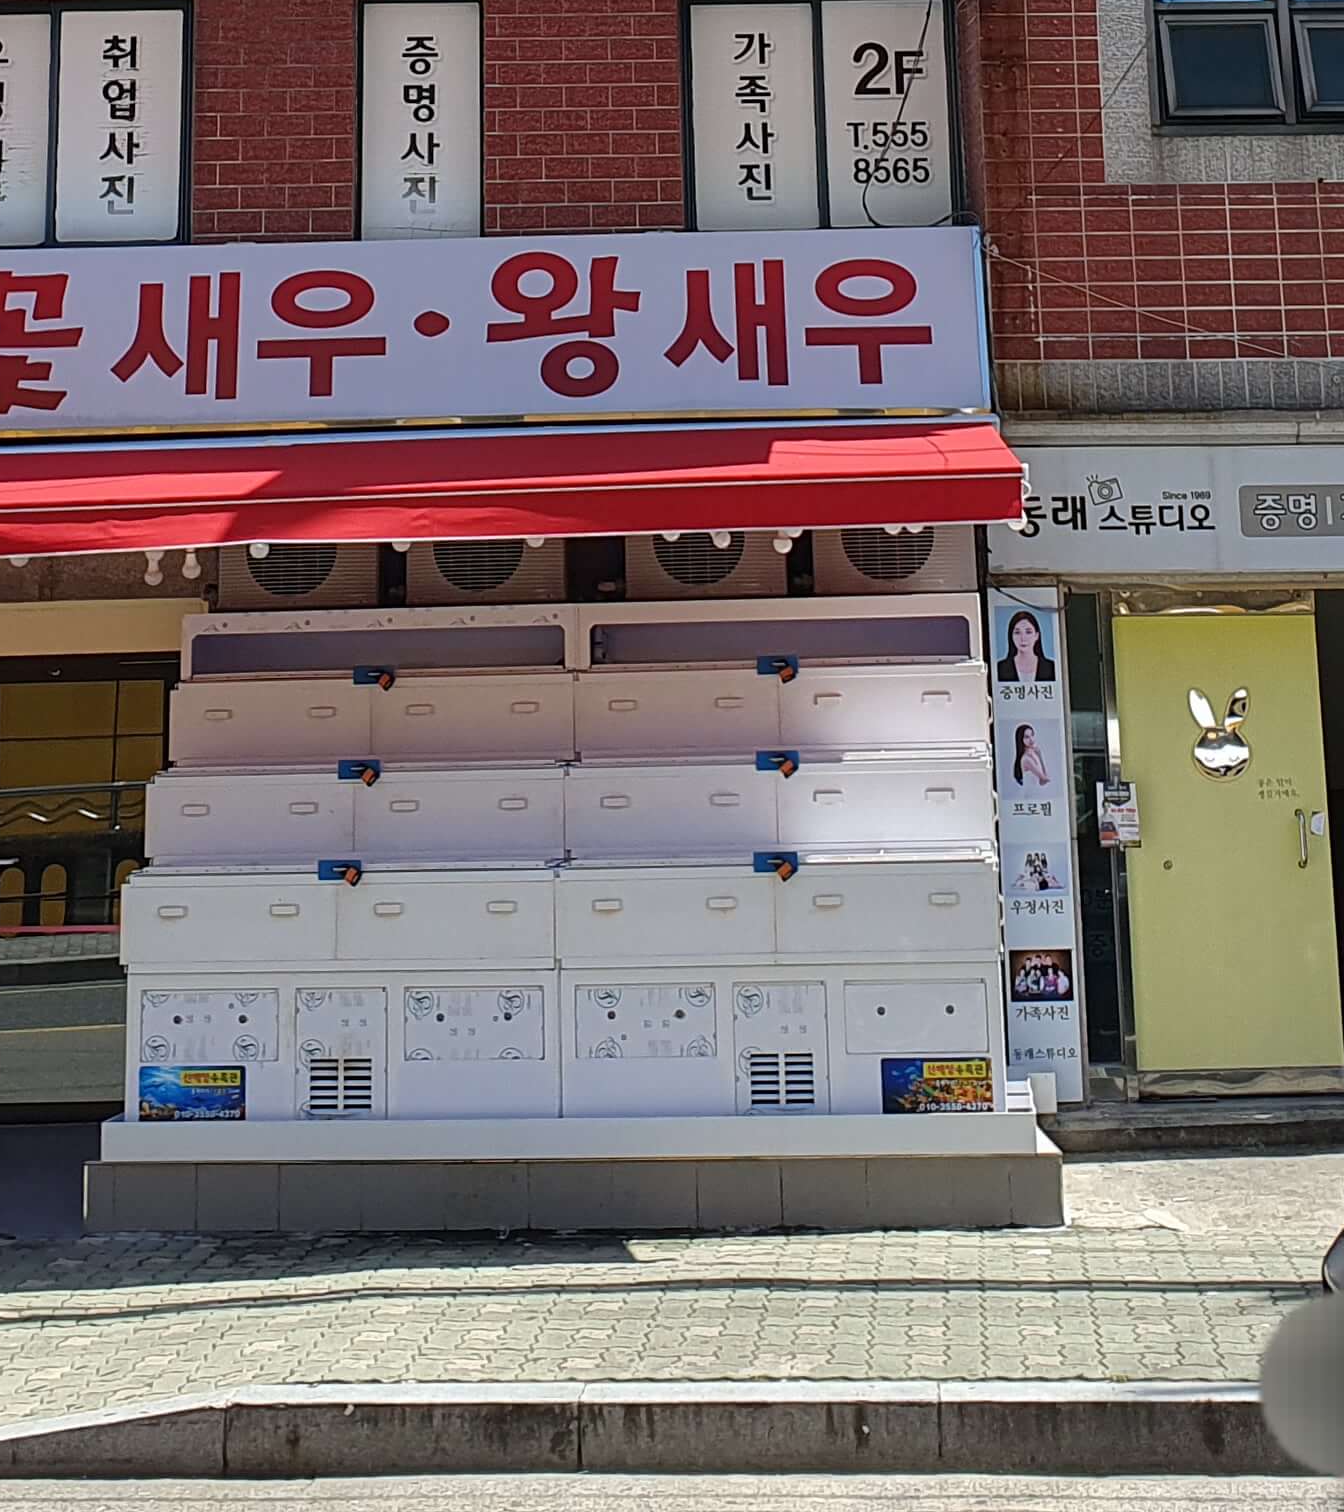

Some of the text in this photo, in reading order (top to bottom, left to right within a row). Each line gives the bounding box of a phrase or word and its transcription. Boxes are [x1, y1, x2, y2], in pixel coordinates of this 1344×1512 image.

[853, 42, 924, 96] 2F
[99, 34, 141, 216] 취업사진
[401, 35, 441, 215] 증명사진
[733, 32, 775, 201] 가족사진
[846, 121, 929, 150] T.555
[853, 157, 930, 184] 8565
[1098, 504, 1216, 536] 스튜디오
[1253, 493, 1319, 531] 증명
[1000, 686, 1054, 700] 증명사진
[1010, 899, 1064, 914] 우정사진
[1015, 1006, 1070, 1021] 가족사진
